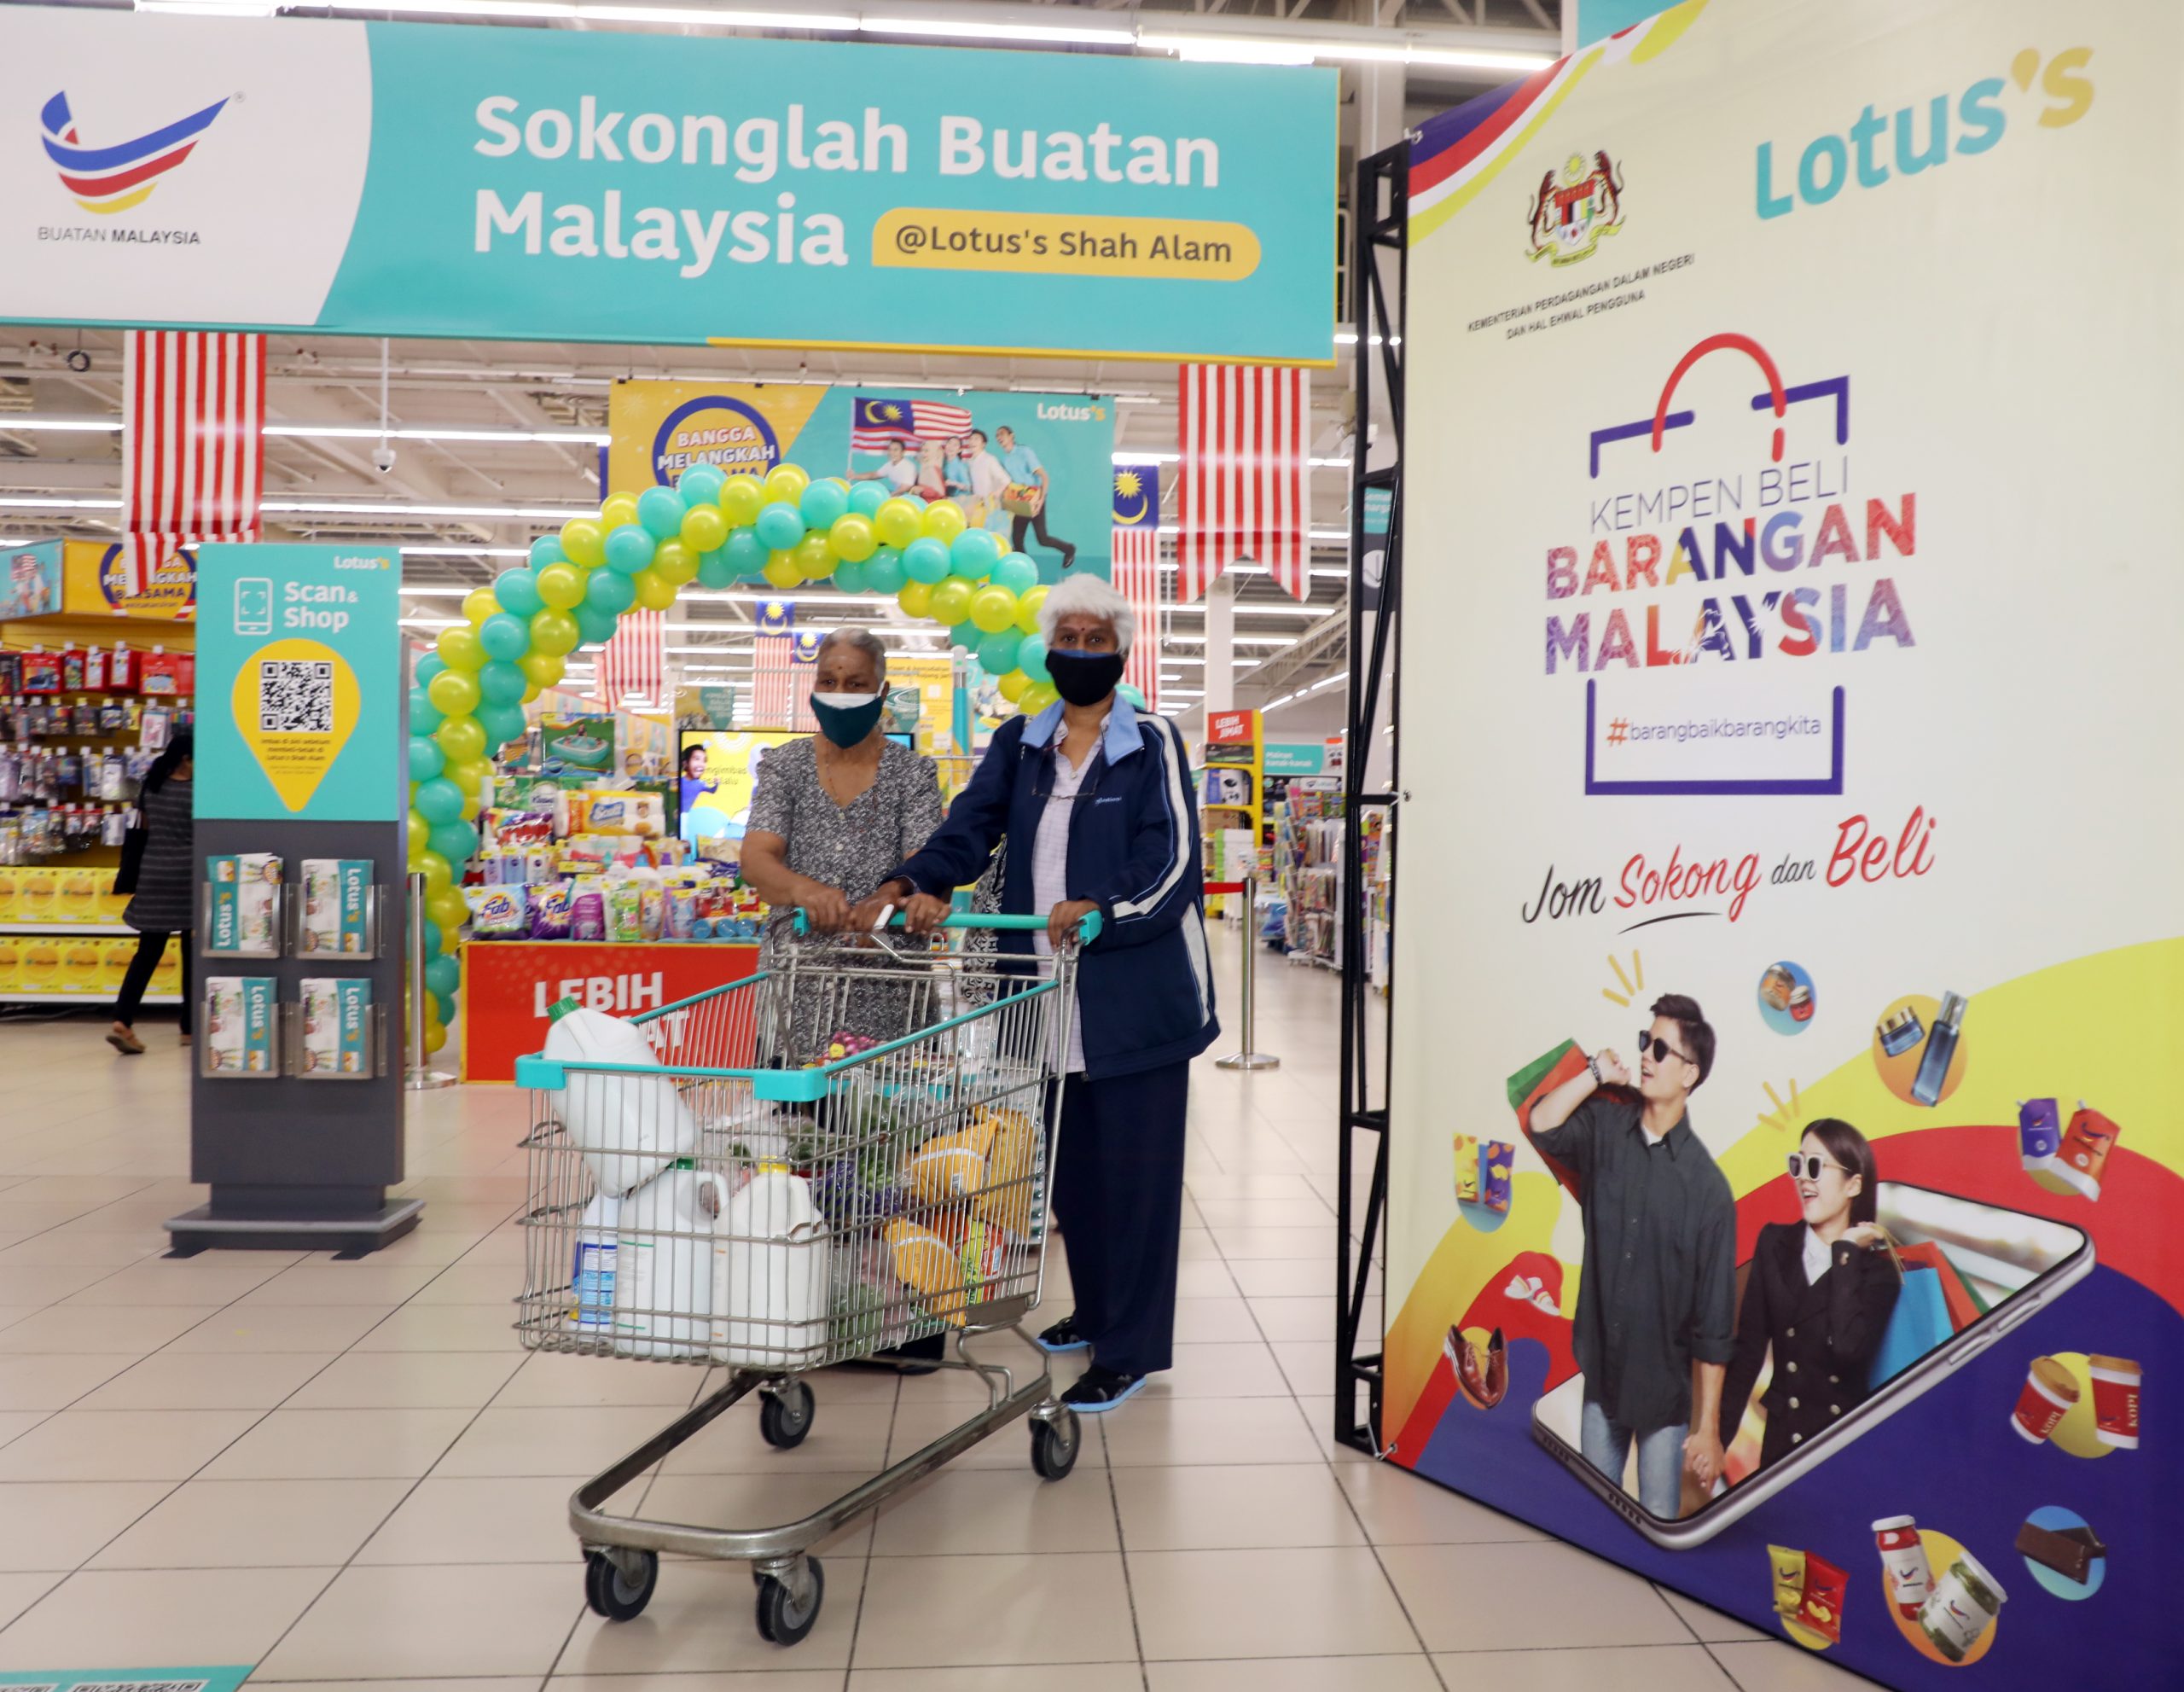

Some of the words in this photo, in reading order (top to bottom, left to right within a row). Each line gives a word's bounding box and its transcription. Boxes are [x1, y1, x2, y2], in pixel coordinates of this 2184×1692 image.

[473, 95, 909, 183] Sokonglah
[939, 114, 1219, 188] Buatan
[1757, 47, 2095, 220] Lotus's
[38, 226, 107, 242] BUATAN
[111, 228, 201, 246] MALAYSIA
[473, 189, 849, 278] Malaysia
[895, 223, 1049, 256] @Lotus's
[1059, 230, 1138, 259] Shah
[1149, 235, 1232, 264] Alam
[1467, 304, 1533, 333] KEMENTERIAN
[1535, 281, 1612, 312] PERDAGANGAN
[1612, 266, 1652, 288] DALAM
[1653, 253, 1695, 276] NEGERI
[1506, 324, 1527, 340] DAN
[1528, 320, 1548, 333] HAL
[1550, 308, 1584, 328] EHWAL
[1586, 289, 1646, 316] PENGGUNA
[677, 426, 757, 448] BANGGA
[1037, 403, 1107, 422] Lotus's
[657, 444, 776, 471] MELANGKAH
[1590, 474, 1742, 534] KEMPEN
[1760, 455, 1849, 508] BELI
[334, 555, 390, 571] Lotus's
[1546, 491, 1917, 601] BARANGAN
[283, 608, 350, 634] Shop
[1544, 577, 1917, 676] MALAYSIA
[1606, 715, 1822, 747] #barangbaikbarangkita
[1522, 863, 1606, 924] Jom
[1613, 843, 1763, 923] Sokong
[1770, 852, 1817, 886] dan
[1826, 805, 1937, 889] Beli
[217, 892, 233, 947] Lotus's
[346, 868, 362, 922] Lotus's
[251, 986, 266, 1040] Lotus's
[345, 986, 361, 1042] Lotus's
[534, 971, 664, 1018] LEBIH
